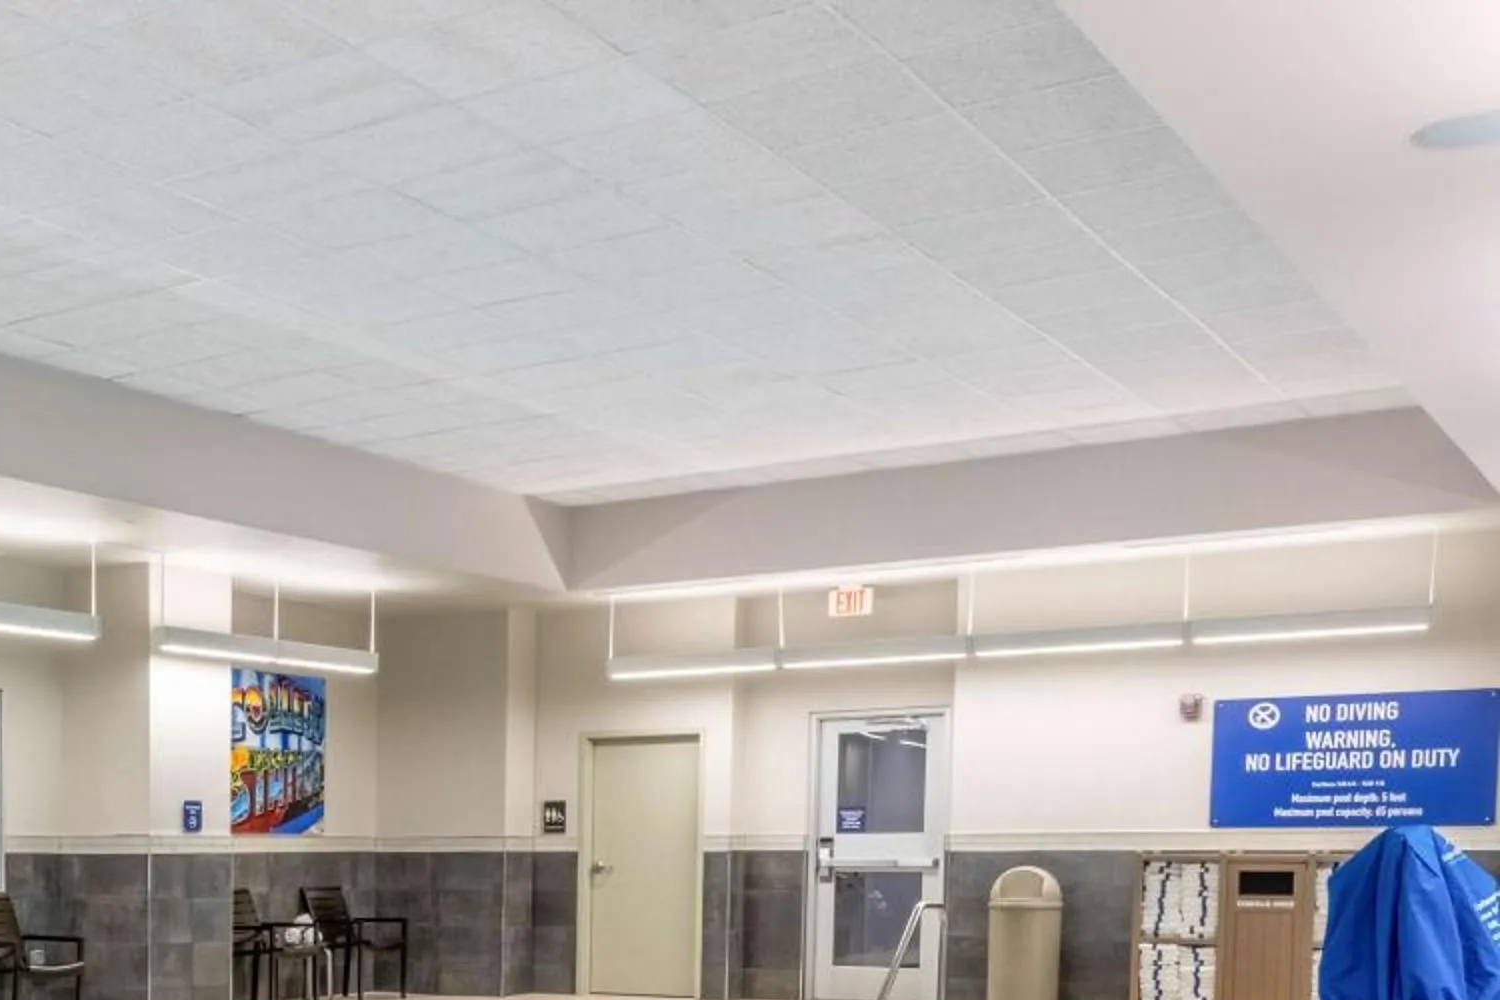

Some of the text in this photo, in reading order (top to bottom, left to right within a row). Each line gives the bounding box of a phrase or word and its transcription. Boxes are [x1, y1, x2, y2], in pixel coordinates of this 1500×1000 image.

[836, 590, 866, 614] EXIT
[1305, 701, 1399, 723] NO DIVING
[1245, 748, 1460, 772] NO LIFEGUARD ON DUTY
[1291, 792, 1332, 804] Maximum
[1333, 792, 1352, 805] pool
[1273, 807, 1314, 817] Maximum
[1315, 806, 1335, 819] pool
